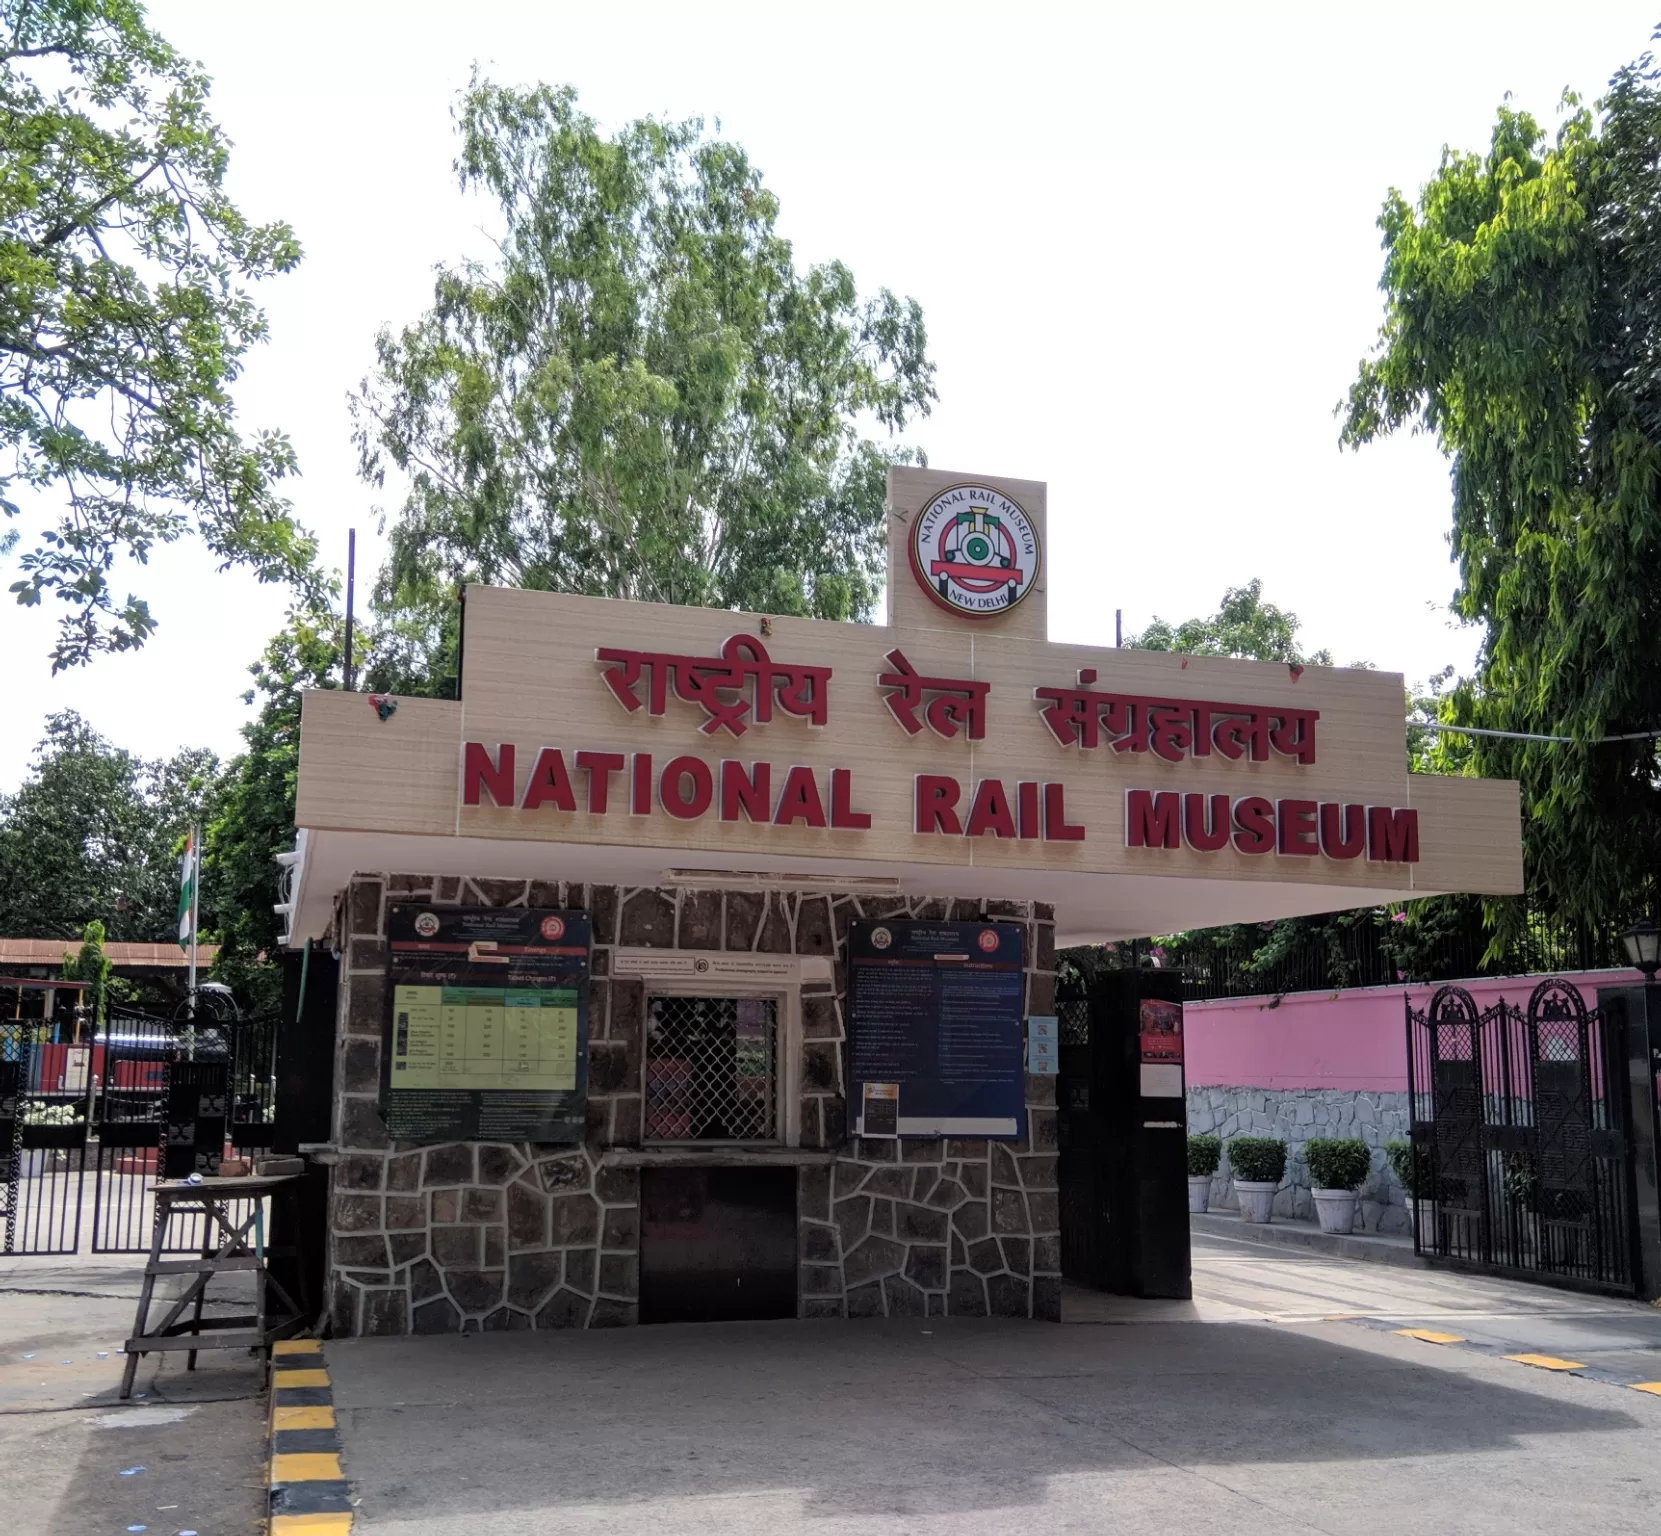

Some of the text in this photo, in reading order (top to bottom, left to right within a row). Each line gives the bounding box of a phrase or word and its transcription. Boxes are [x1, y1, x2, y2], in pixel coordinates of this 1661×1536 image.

[921, 490, 1034, 555] NATIONAL RAIL MUSEUM
[950, 589, 1008, 608] NEW DELHI
[594, 633, 1320, 765] राष्ट्रीय रेल संग्रहालय
[463, 741, 1420, 863] NATIONAL RAIL MUSEUM
